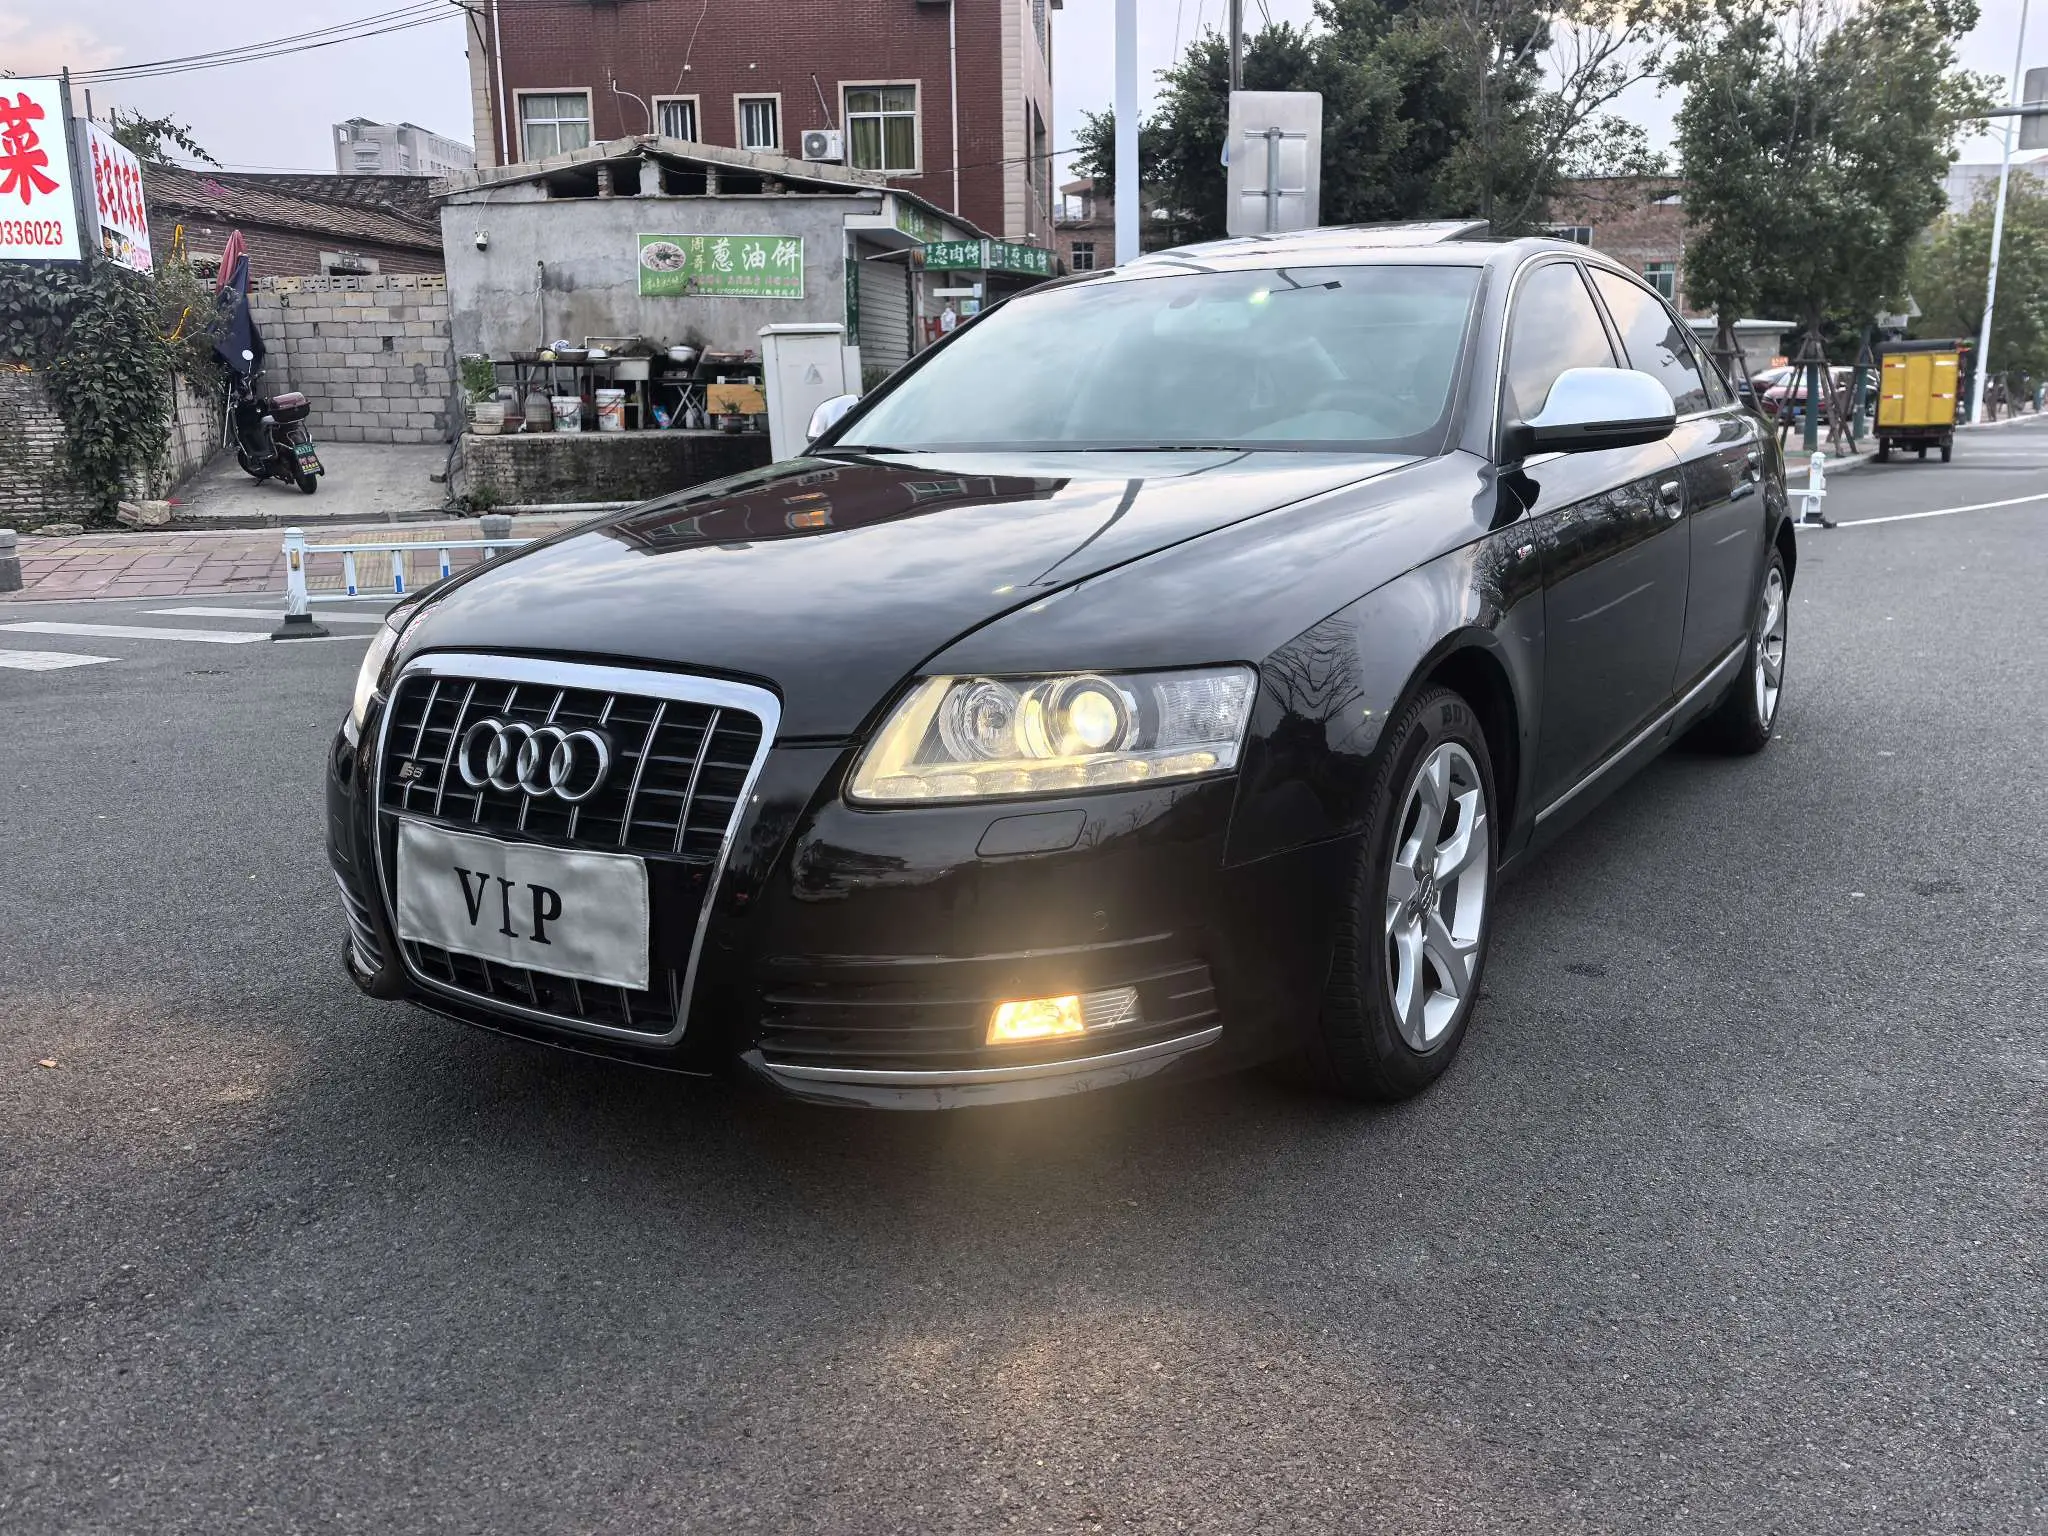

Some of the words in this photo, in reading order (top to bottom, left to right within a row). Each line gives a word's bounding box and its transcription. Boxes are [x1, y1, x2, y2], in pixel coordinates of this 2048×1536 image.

[0, 92, 60, 206] 菜
[711, 237, 800, 273] 葱油饼
[454, 866, 563, 945] VIP
